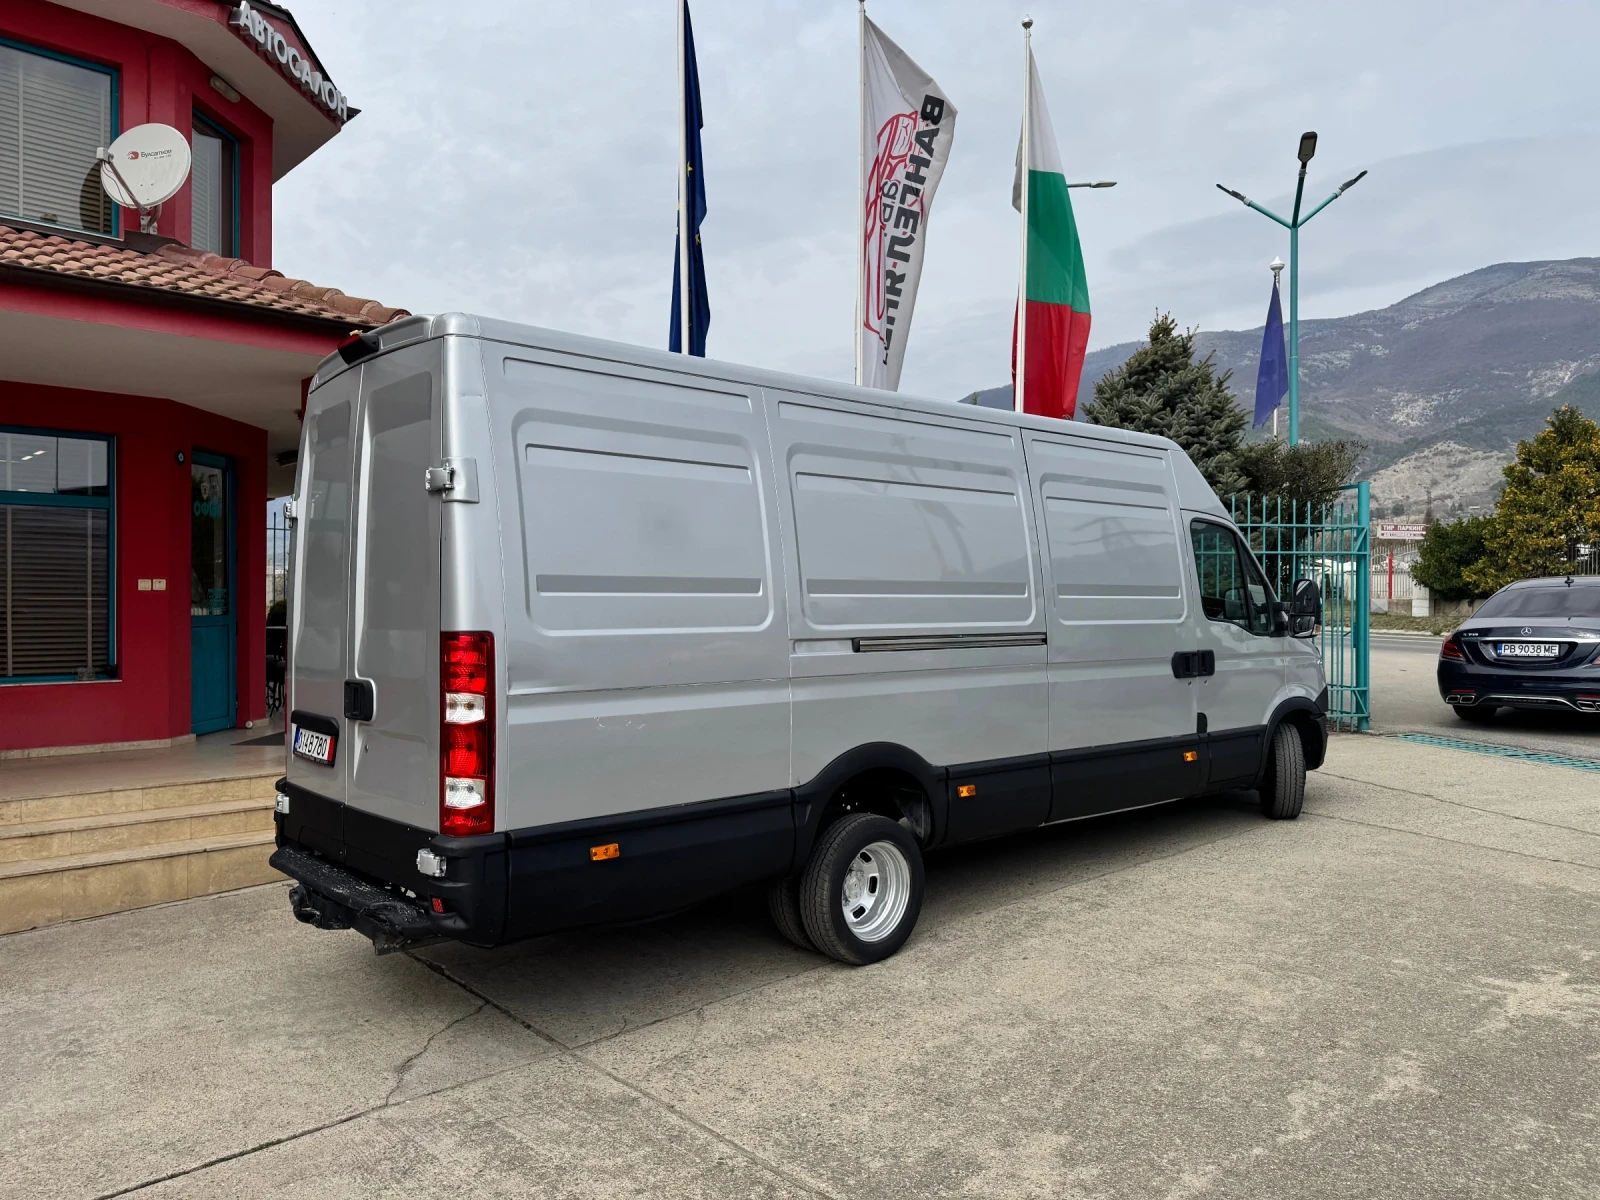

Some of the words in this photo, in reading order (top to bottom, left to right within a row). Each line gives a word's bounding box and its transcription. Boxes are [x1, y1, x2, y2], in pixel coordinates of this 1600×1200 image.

[238, 1, 347, 122] АВТОСАЛОН
[1503, 645, 1516, 653] PB
[1518, 645, 1542, 653] 9038
[1543, 645, 1556, 654] ME
